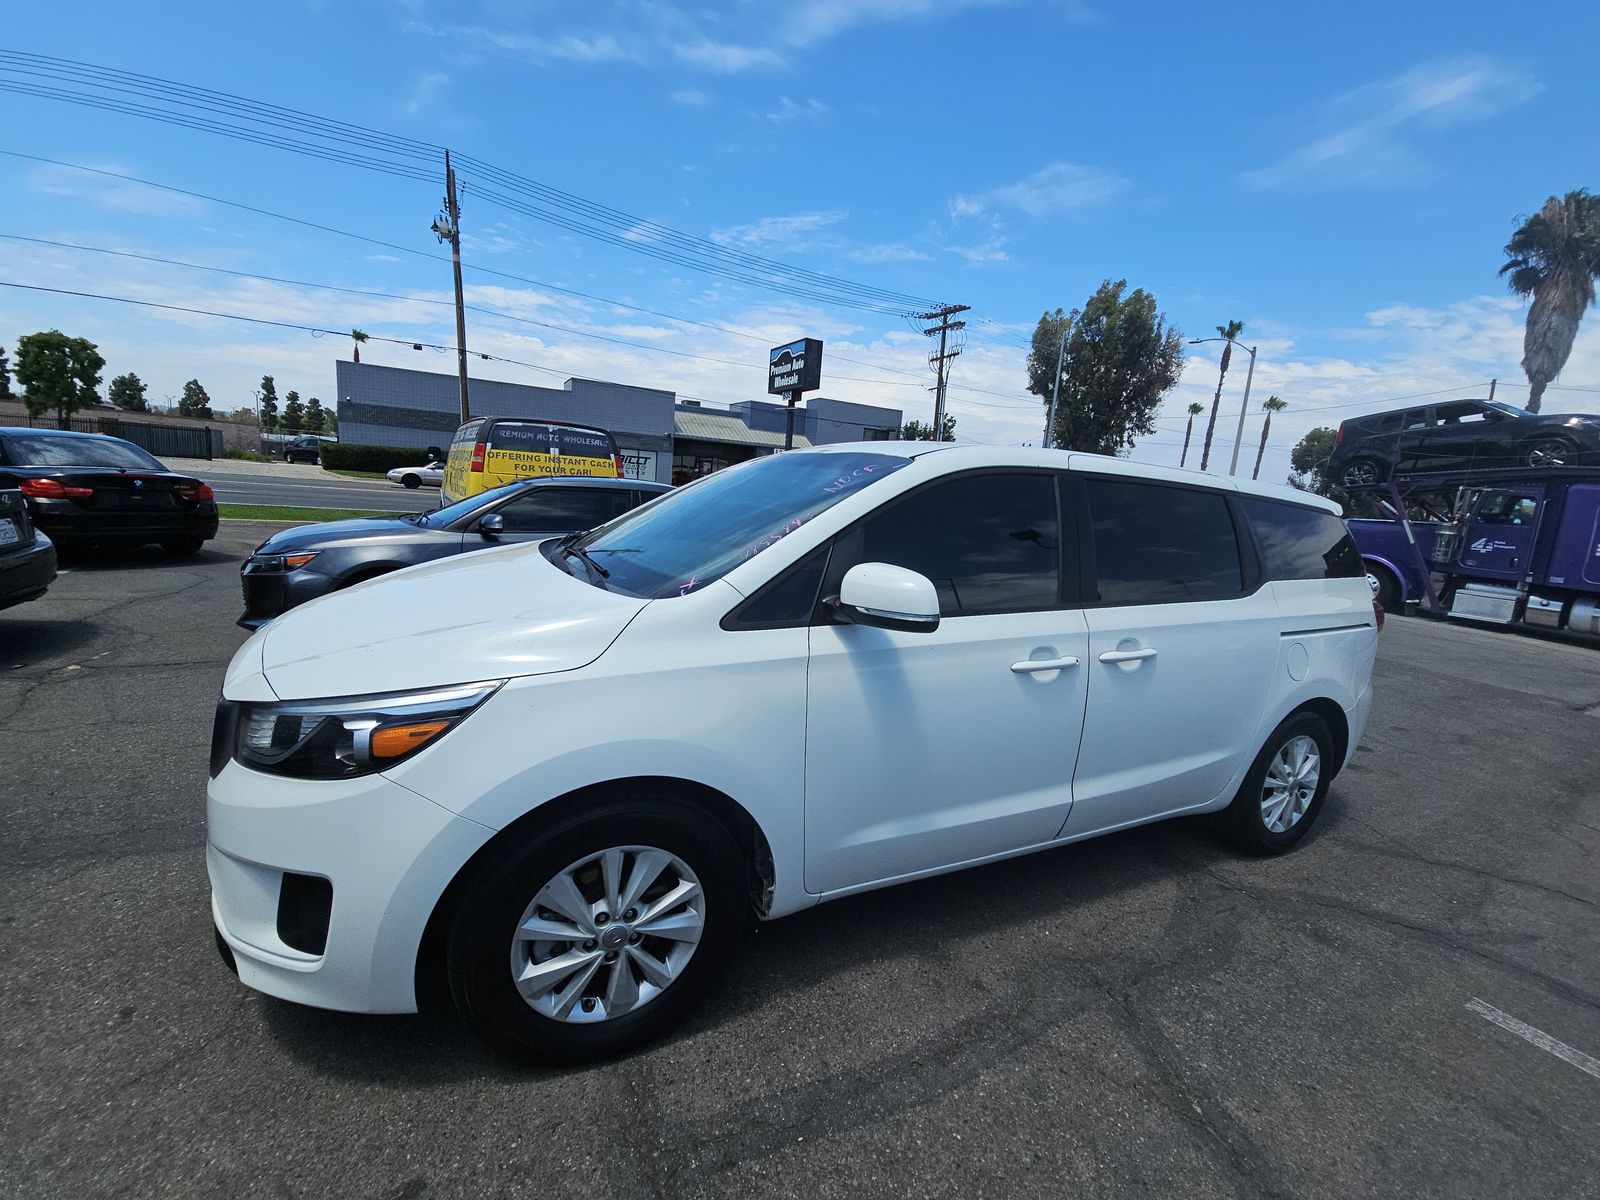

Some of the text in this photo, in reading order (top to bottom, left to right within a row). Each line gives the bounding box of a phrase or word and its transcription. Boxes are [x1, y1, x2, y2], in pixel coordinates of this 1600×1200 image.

[771, 359, 804, 376] Premium Auto
[775, 372, 798, 388] Wholesale
[537, 434, 559, 442] AUTO
[564, 436, 608, 447] WHOLESALE
[487, 451, 541, 462] OFFERING
[544, 456, 587, 466] INSTANT
[590, 460, 614, 469] CASH
[514, 463, 592, 476] FOR YOUR CAR!
